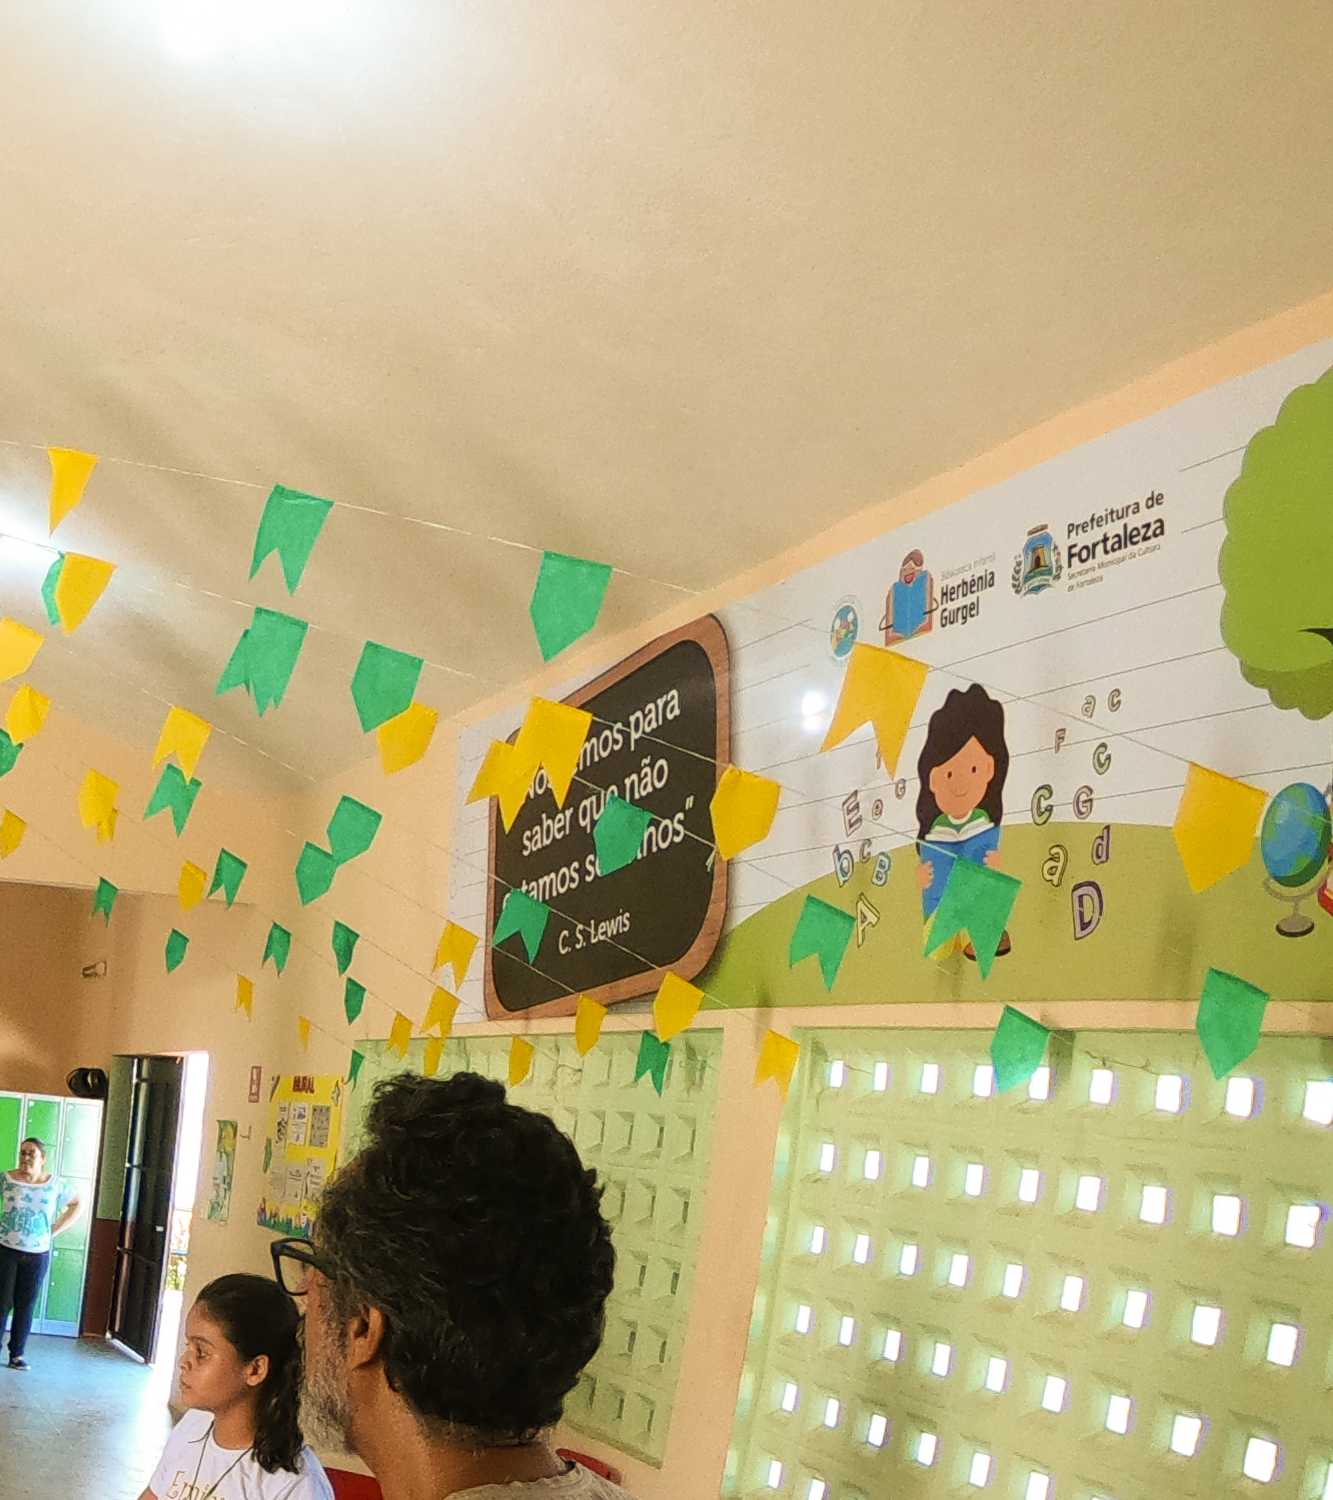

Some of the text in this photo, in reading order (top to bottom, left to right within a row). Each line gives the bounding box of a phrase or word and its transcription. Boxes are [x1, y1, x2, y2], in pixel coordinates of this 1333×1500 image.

[1067, 489, 1164, 540] Prefeitura de
[1067, 518, 1165, 569] Fortaleza
[940, 595, 980, 628] Gurgel
[630, 689, 681, 751] para
[522, 806, 574, 857] saber
[625, 758, 668, 803] não
[559, 908, 631, 954] C. S. Lewis
